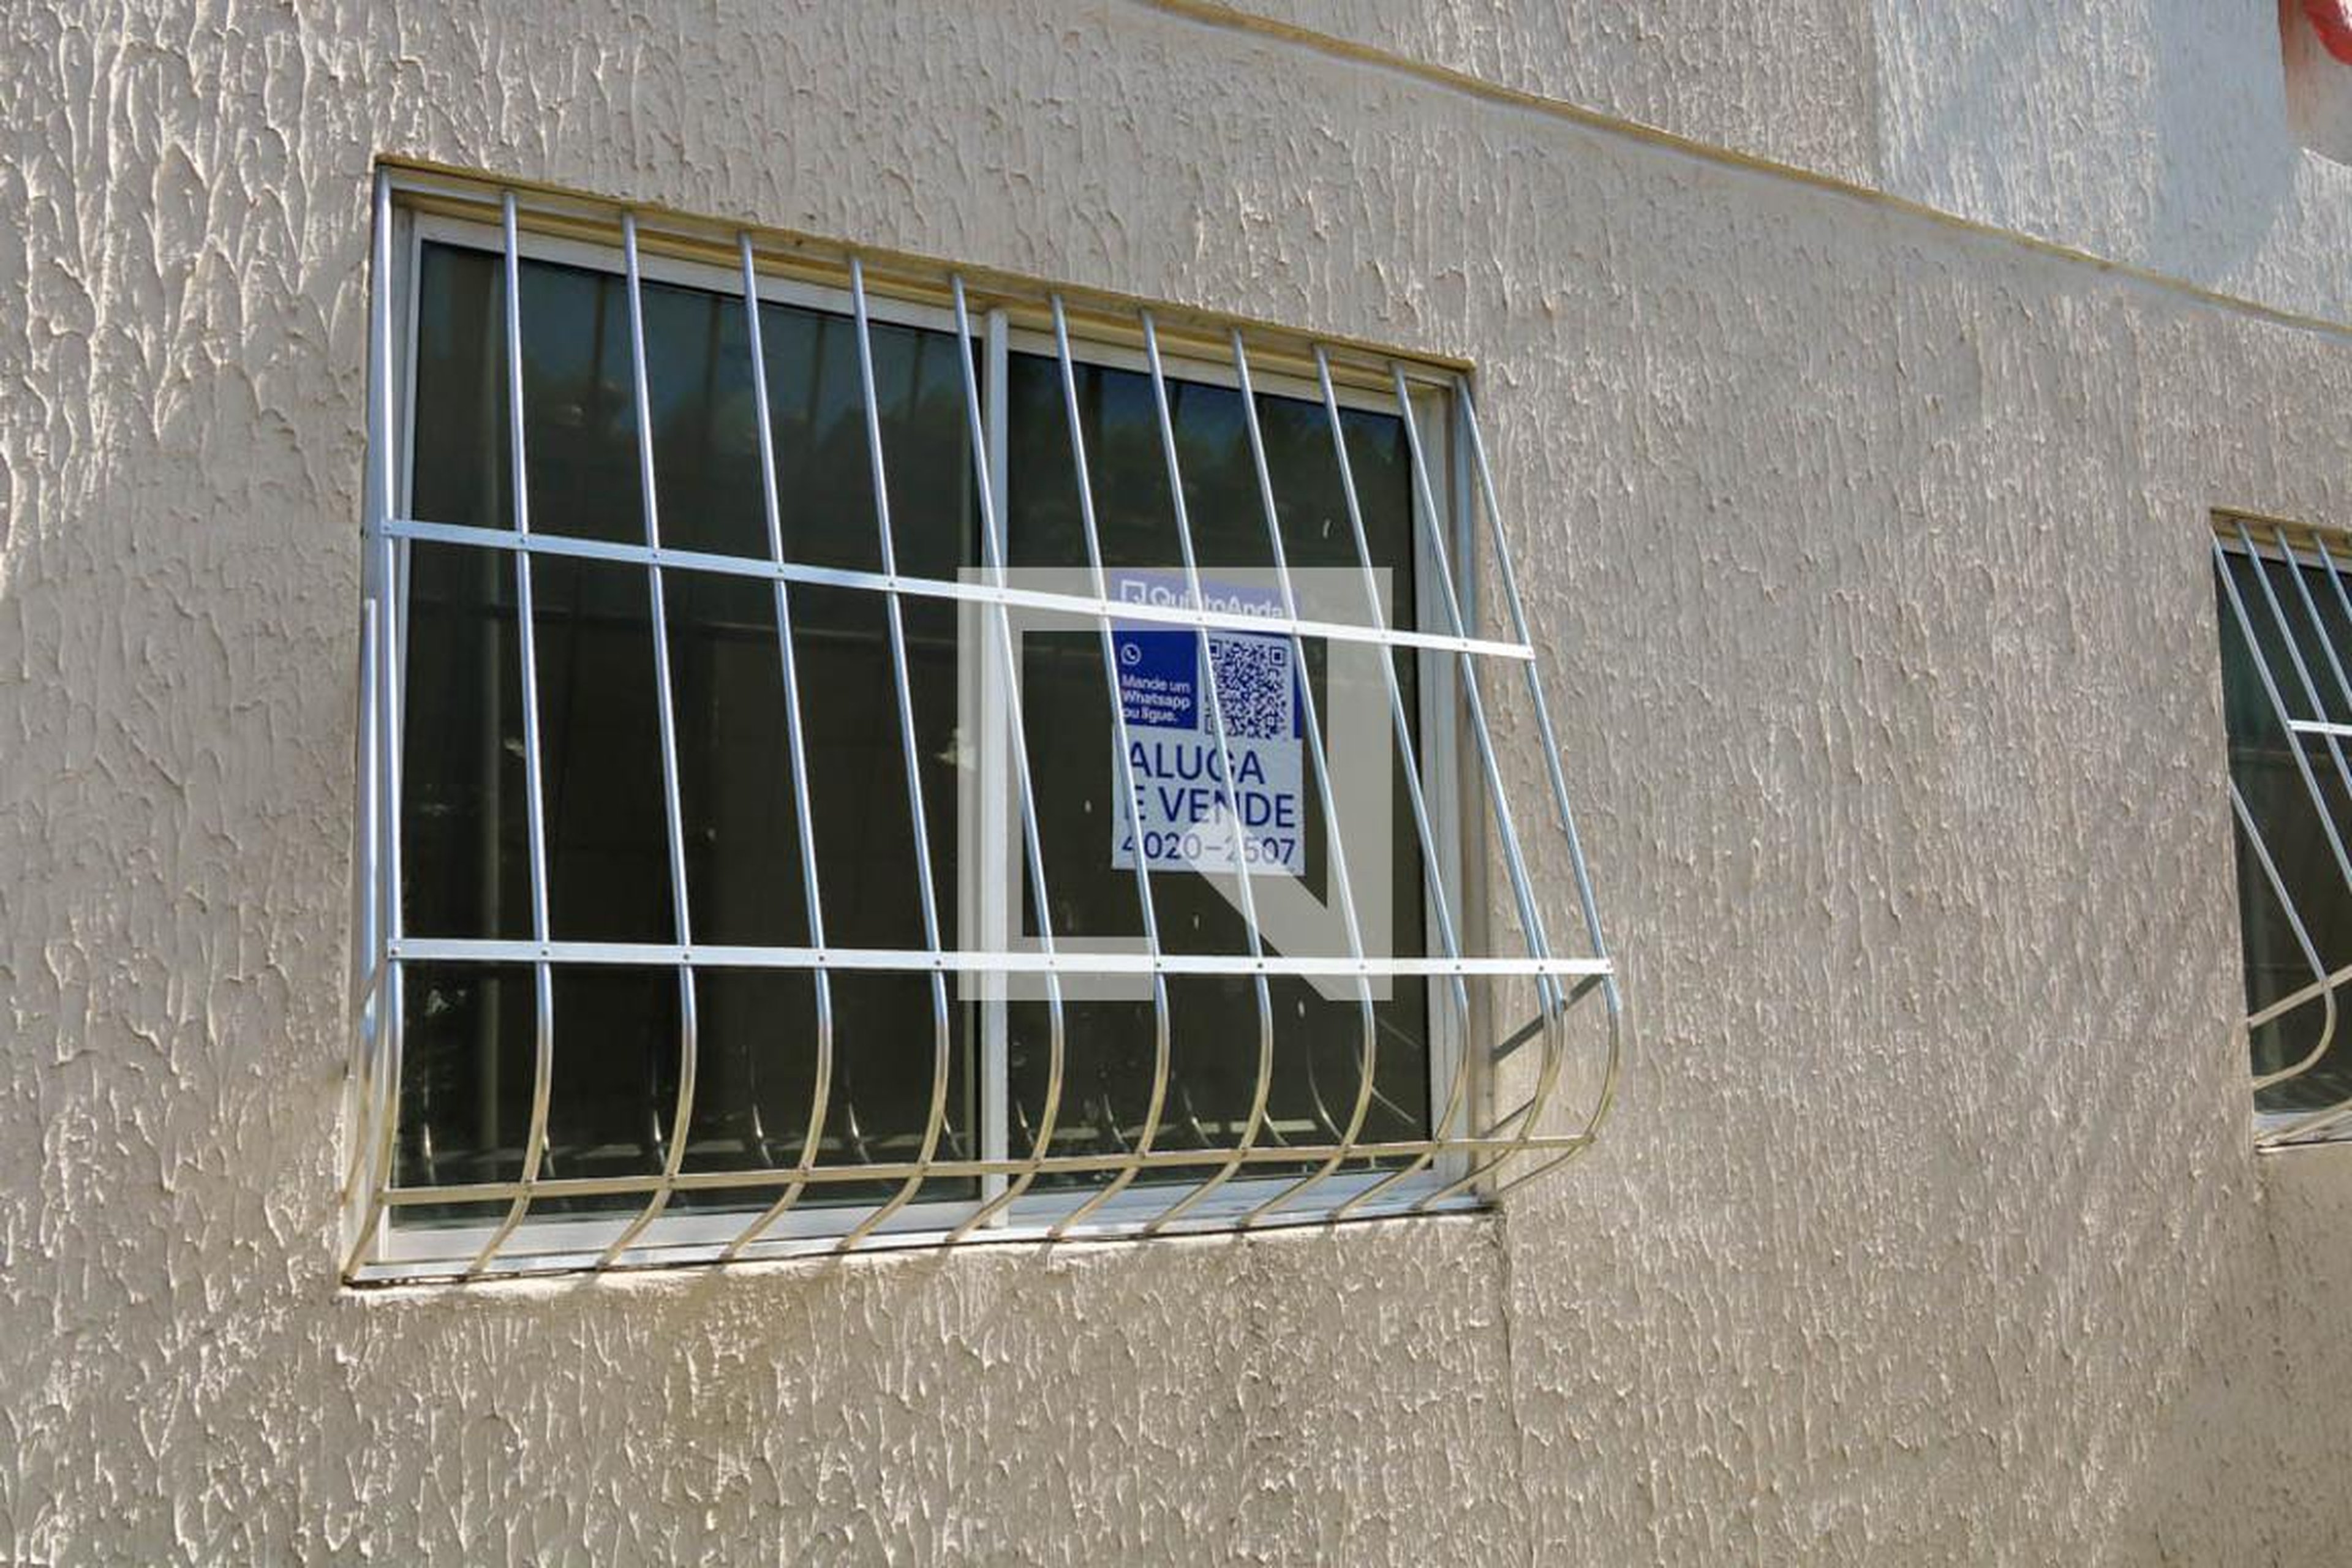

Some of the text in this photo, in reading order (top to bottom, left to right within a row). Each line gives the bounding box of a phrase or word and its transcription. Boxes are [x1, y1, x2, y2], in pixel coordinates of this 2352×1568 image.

[1150, 586, 1286, 619] QuitoAnda
[1122, 674, 1191, 694] Mande um
[1122, 707, 1139, 719] ou
[1131, 741, 1265, 785] ALUGA
[1158, 786, 1295, 828] VENDE
